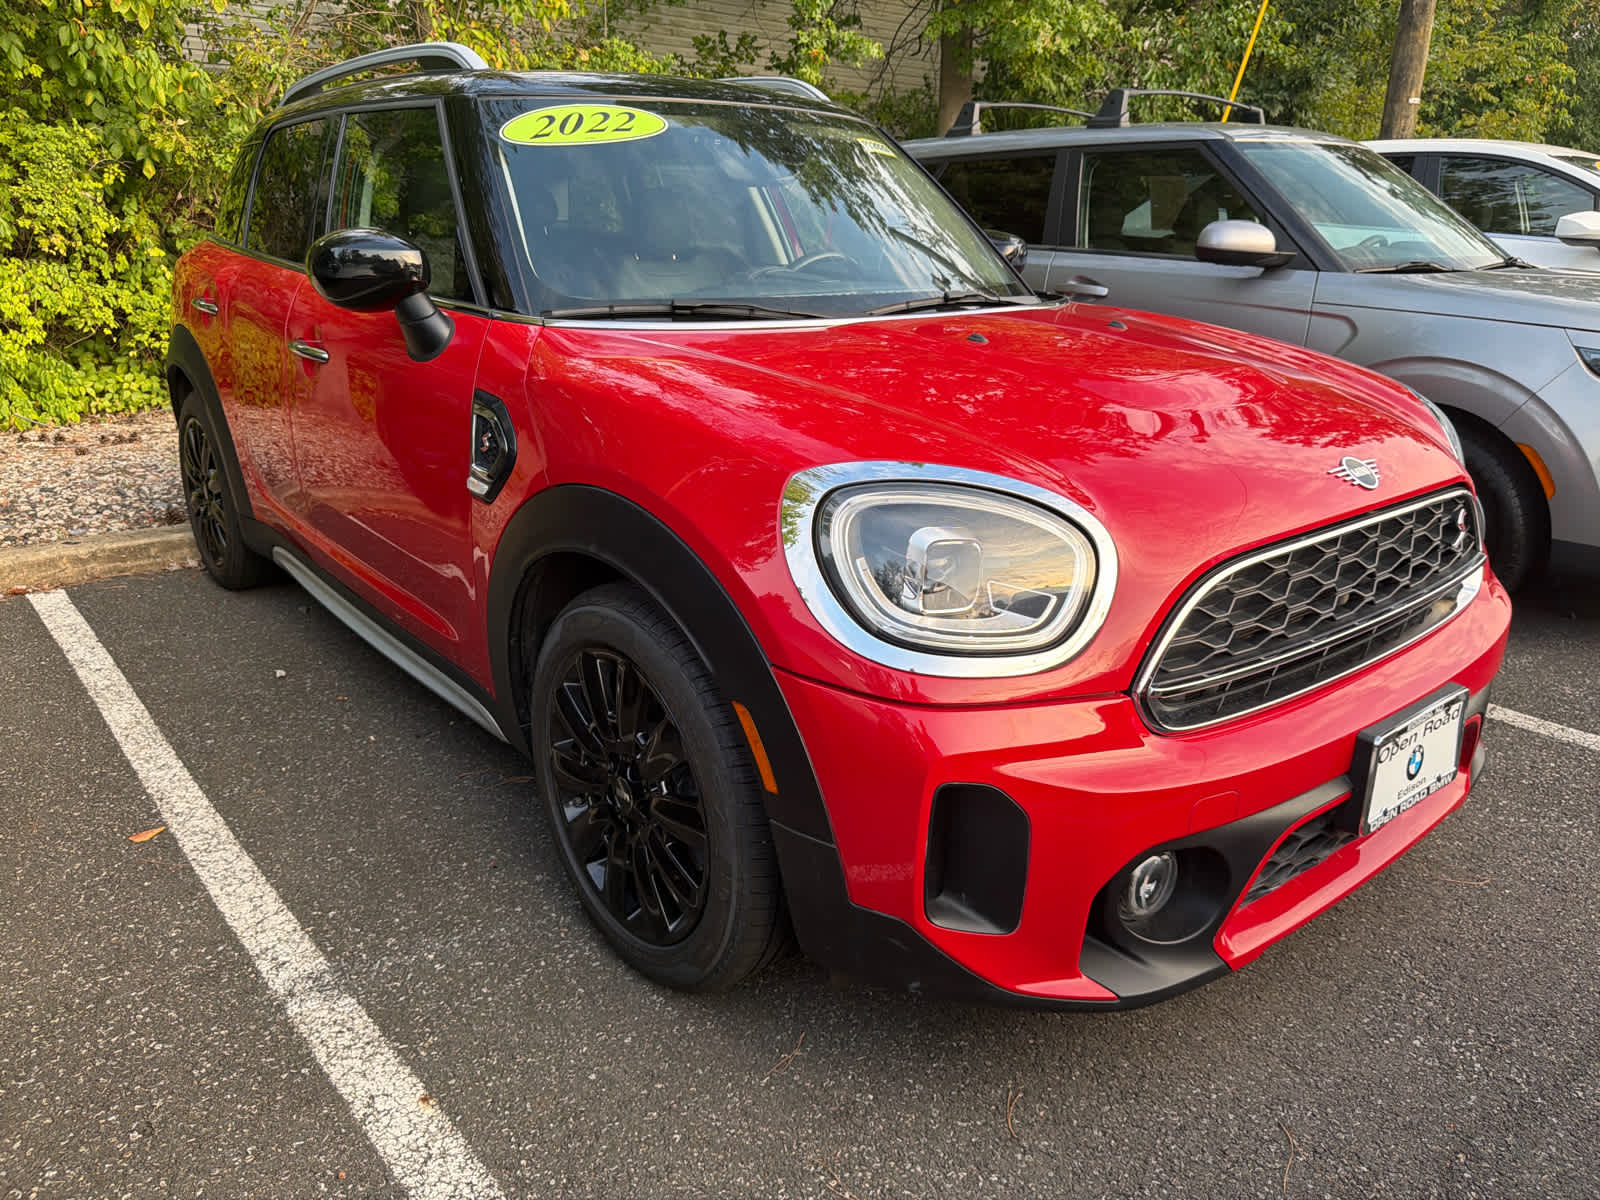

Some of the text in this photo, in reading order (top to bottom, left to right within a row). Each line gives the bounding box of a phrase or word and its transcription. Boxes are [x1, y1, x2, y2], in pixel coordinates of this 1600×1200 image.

[530, 111, 636, 139] 2022
[1378, 732, 1418, 764] Open
[1423, 704, 1461, 737] Road
[1397, 776, 1427, 800] Edison
[1399, 788, 1428, 812] ROAD
